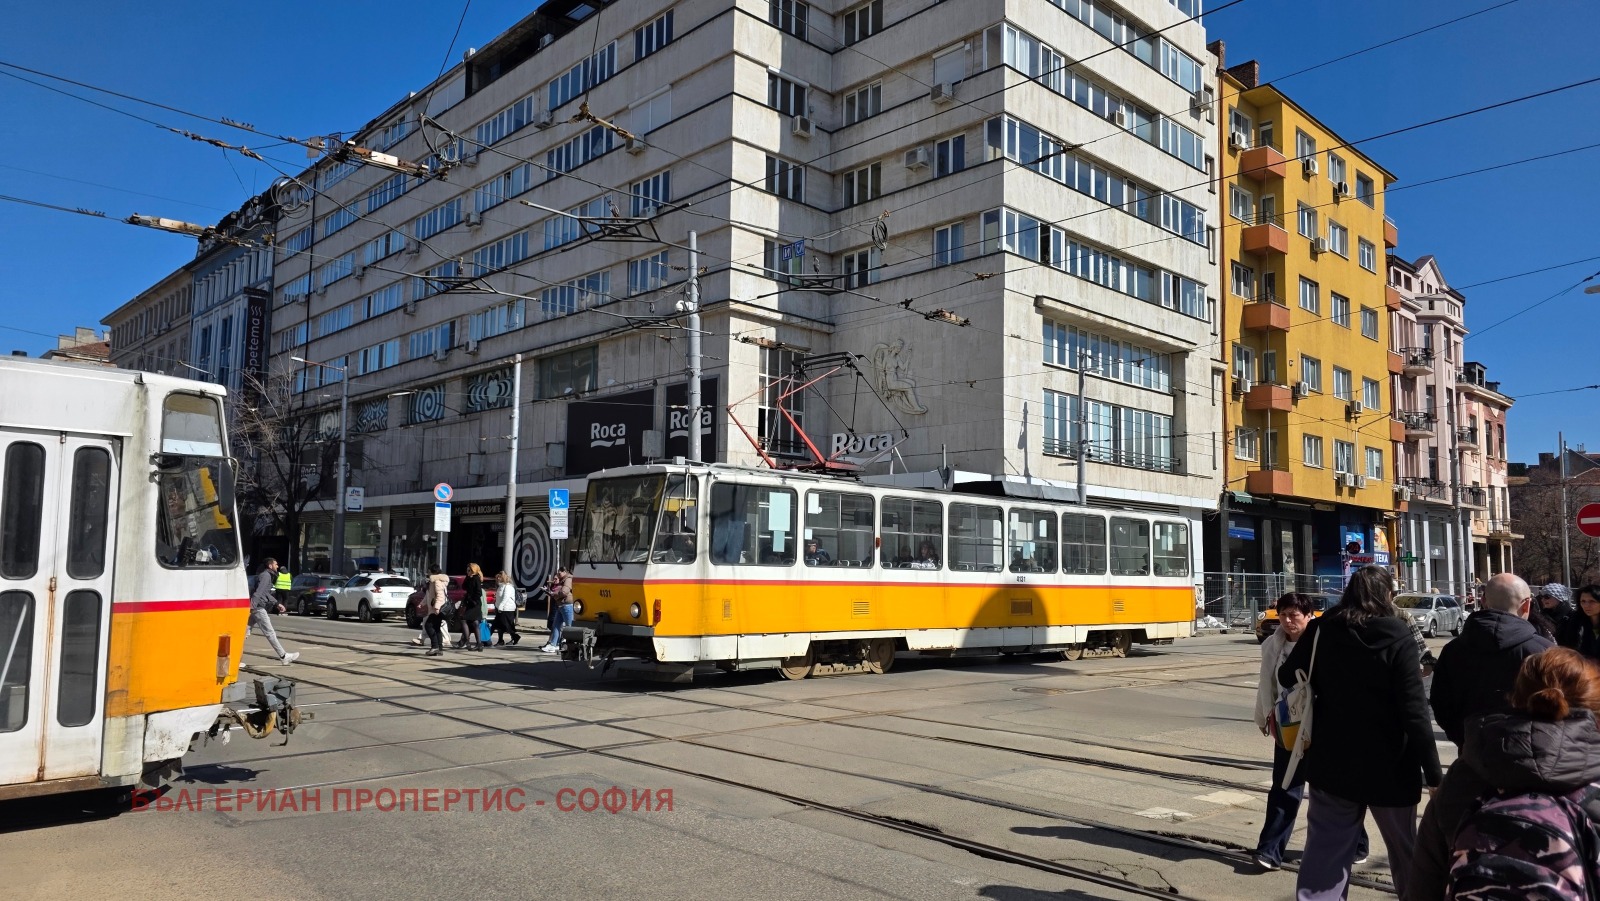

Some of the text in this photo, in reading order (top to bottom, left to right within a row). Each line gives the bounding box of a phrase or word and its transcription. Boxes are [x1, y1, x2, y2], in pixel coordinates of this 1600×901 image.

[245, 317, 261, 375] Spetema
[670, 409, 712, 430] Roa
[590, 422, 626, 440] Roca
[831, 432, 894, 456] Roca
